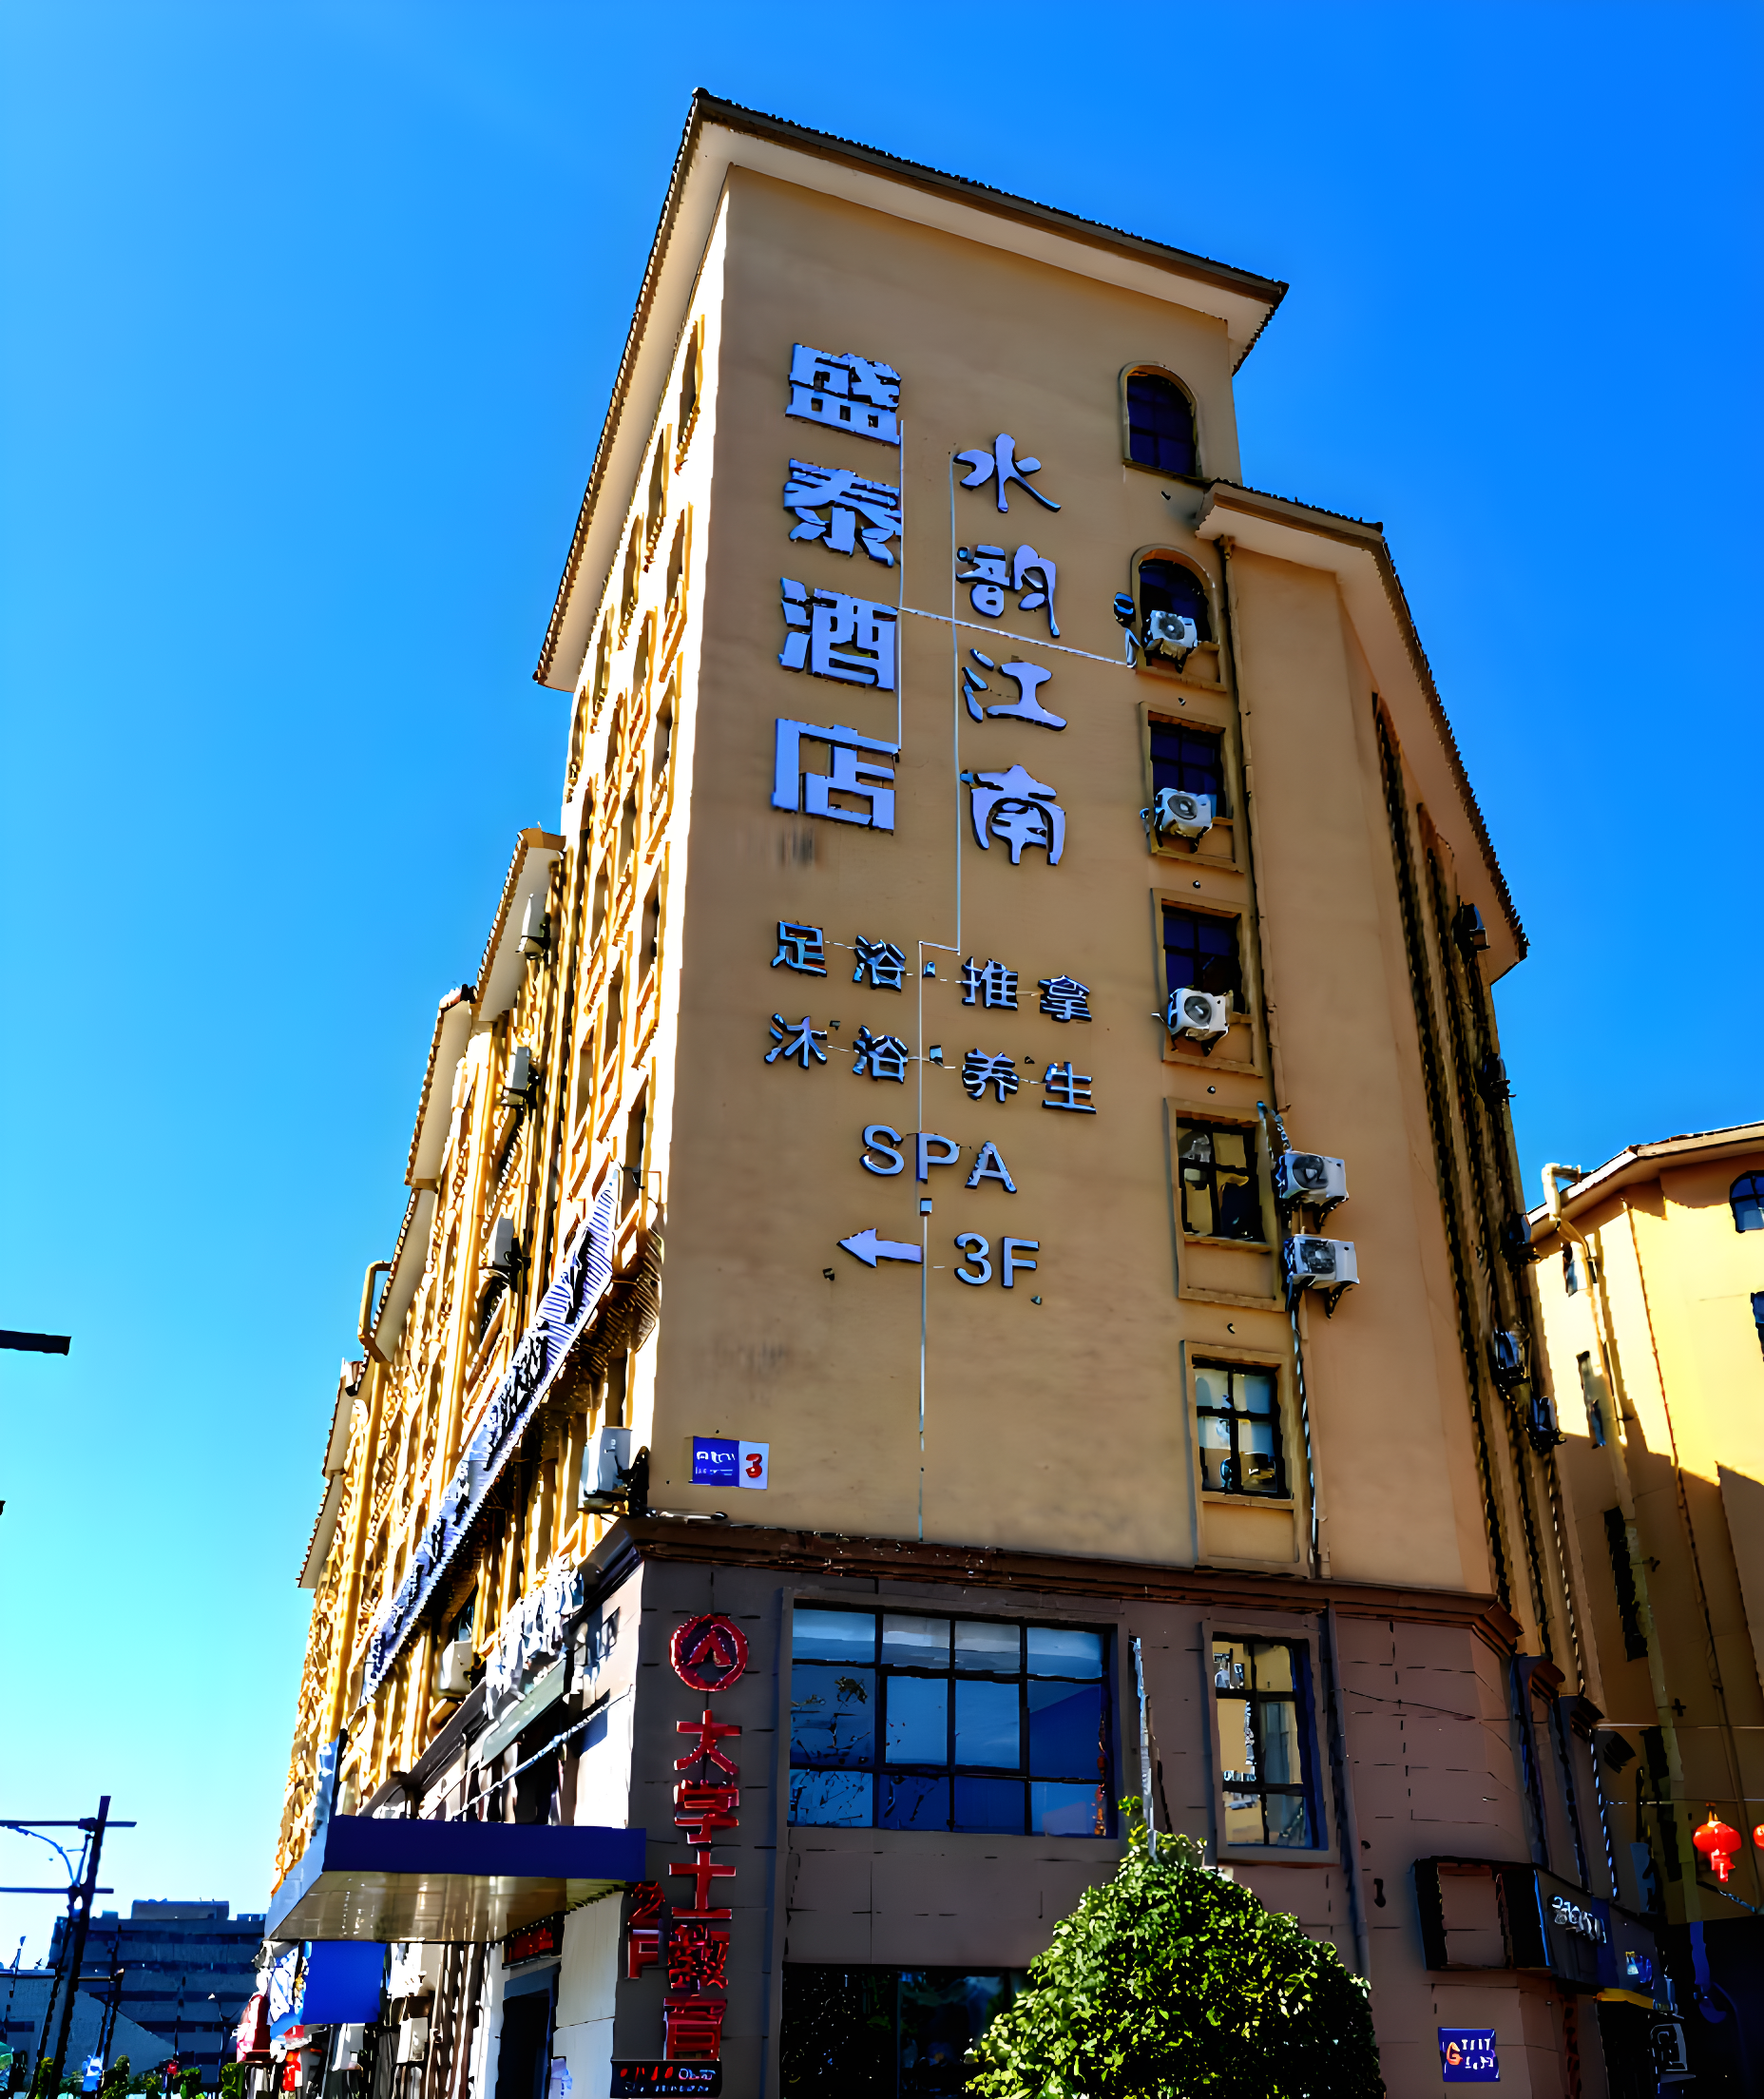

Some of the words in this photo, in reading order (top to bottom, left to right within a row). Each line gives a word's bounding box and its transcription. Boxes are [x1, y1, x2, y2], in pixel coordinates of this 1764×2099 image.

[771, 342, 901, 836] 盛泰酒店
[953, 433, 1067, 865] 水韵江南
[860, 1125, 1017, 1193] SPA
[954, 1232, 1040, 1288] 3F
[746, 1454, 762, 1478] 3
